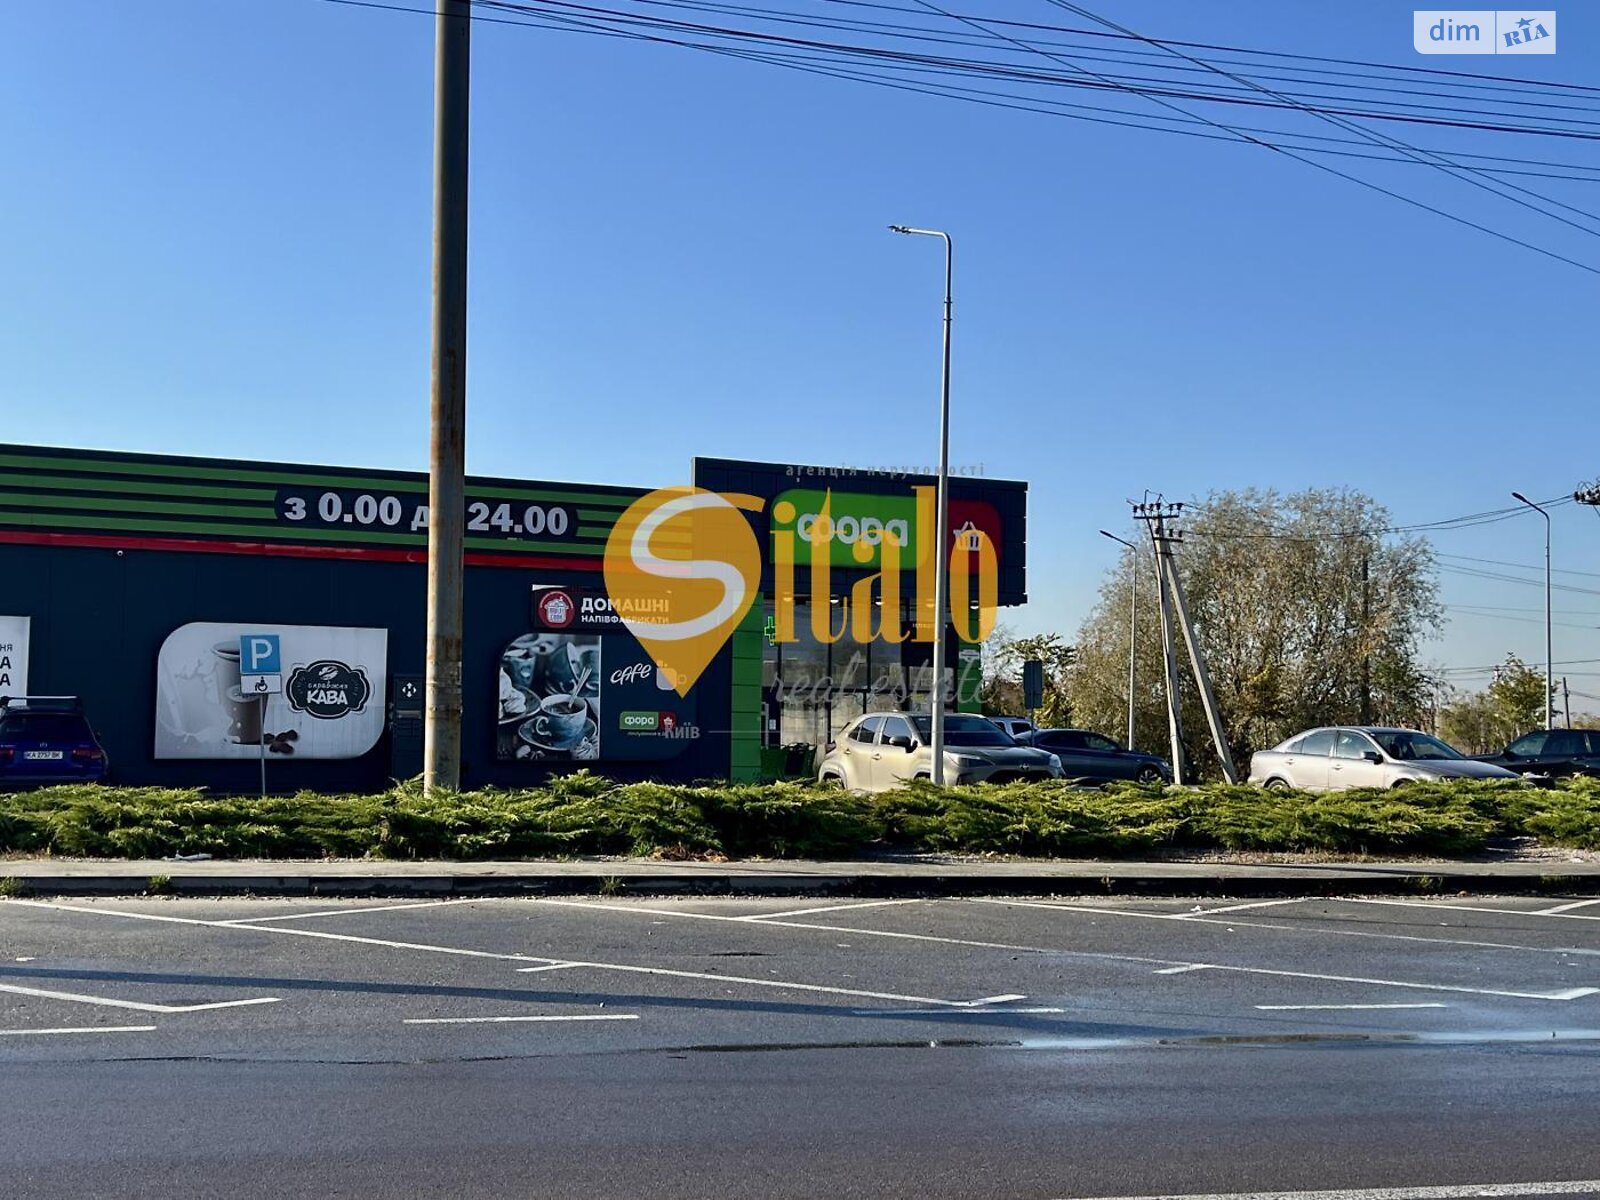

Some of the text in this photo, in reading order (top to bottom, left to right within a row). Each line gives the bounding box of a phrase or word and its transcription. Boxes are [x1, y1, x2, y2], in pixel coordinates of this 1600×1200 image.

[318, 492, 402, 526] 0.00
[467, 501, 569, 536] 24.00
[797, 512, 908, 548] фора
[581, 597, 670, 613] ДОМАШНІ
[581, 615, 670, 625] НАПІВФАБРИКАТИ
[250, 638, 273, 670] P
[306, 690, 349, 705] КАВА
